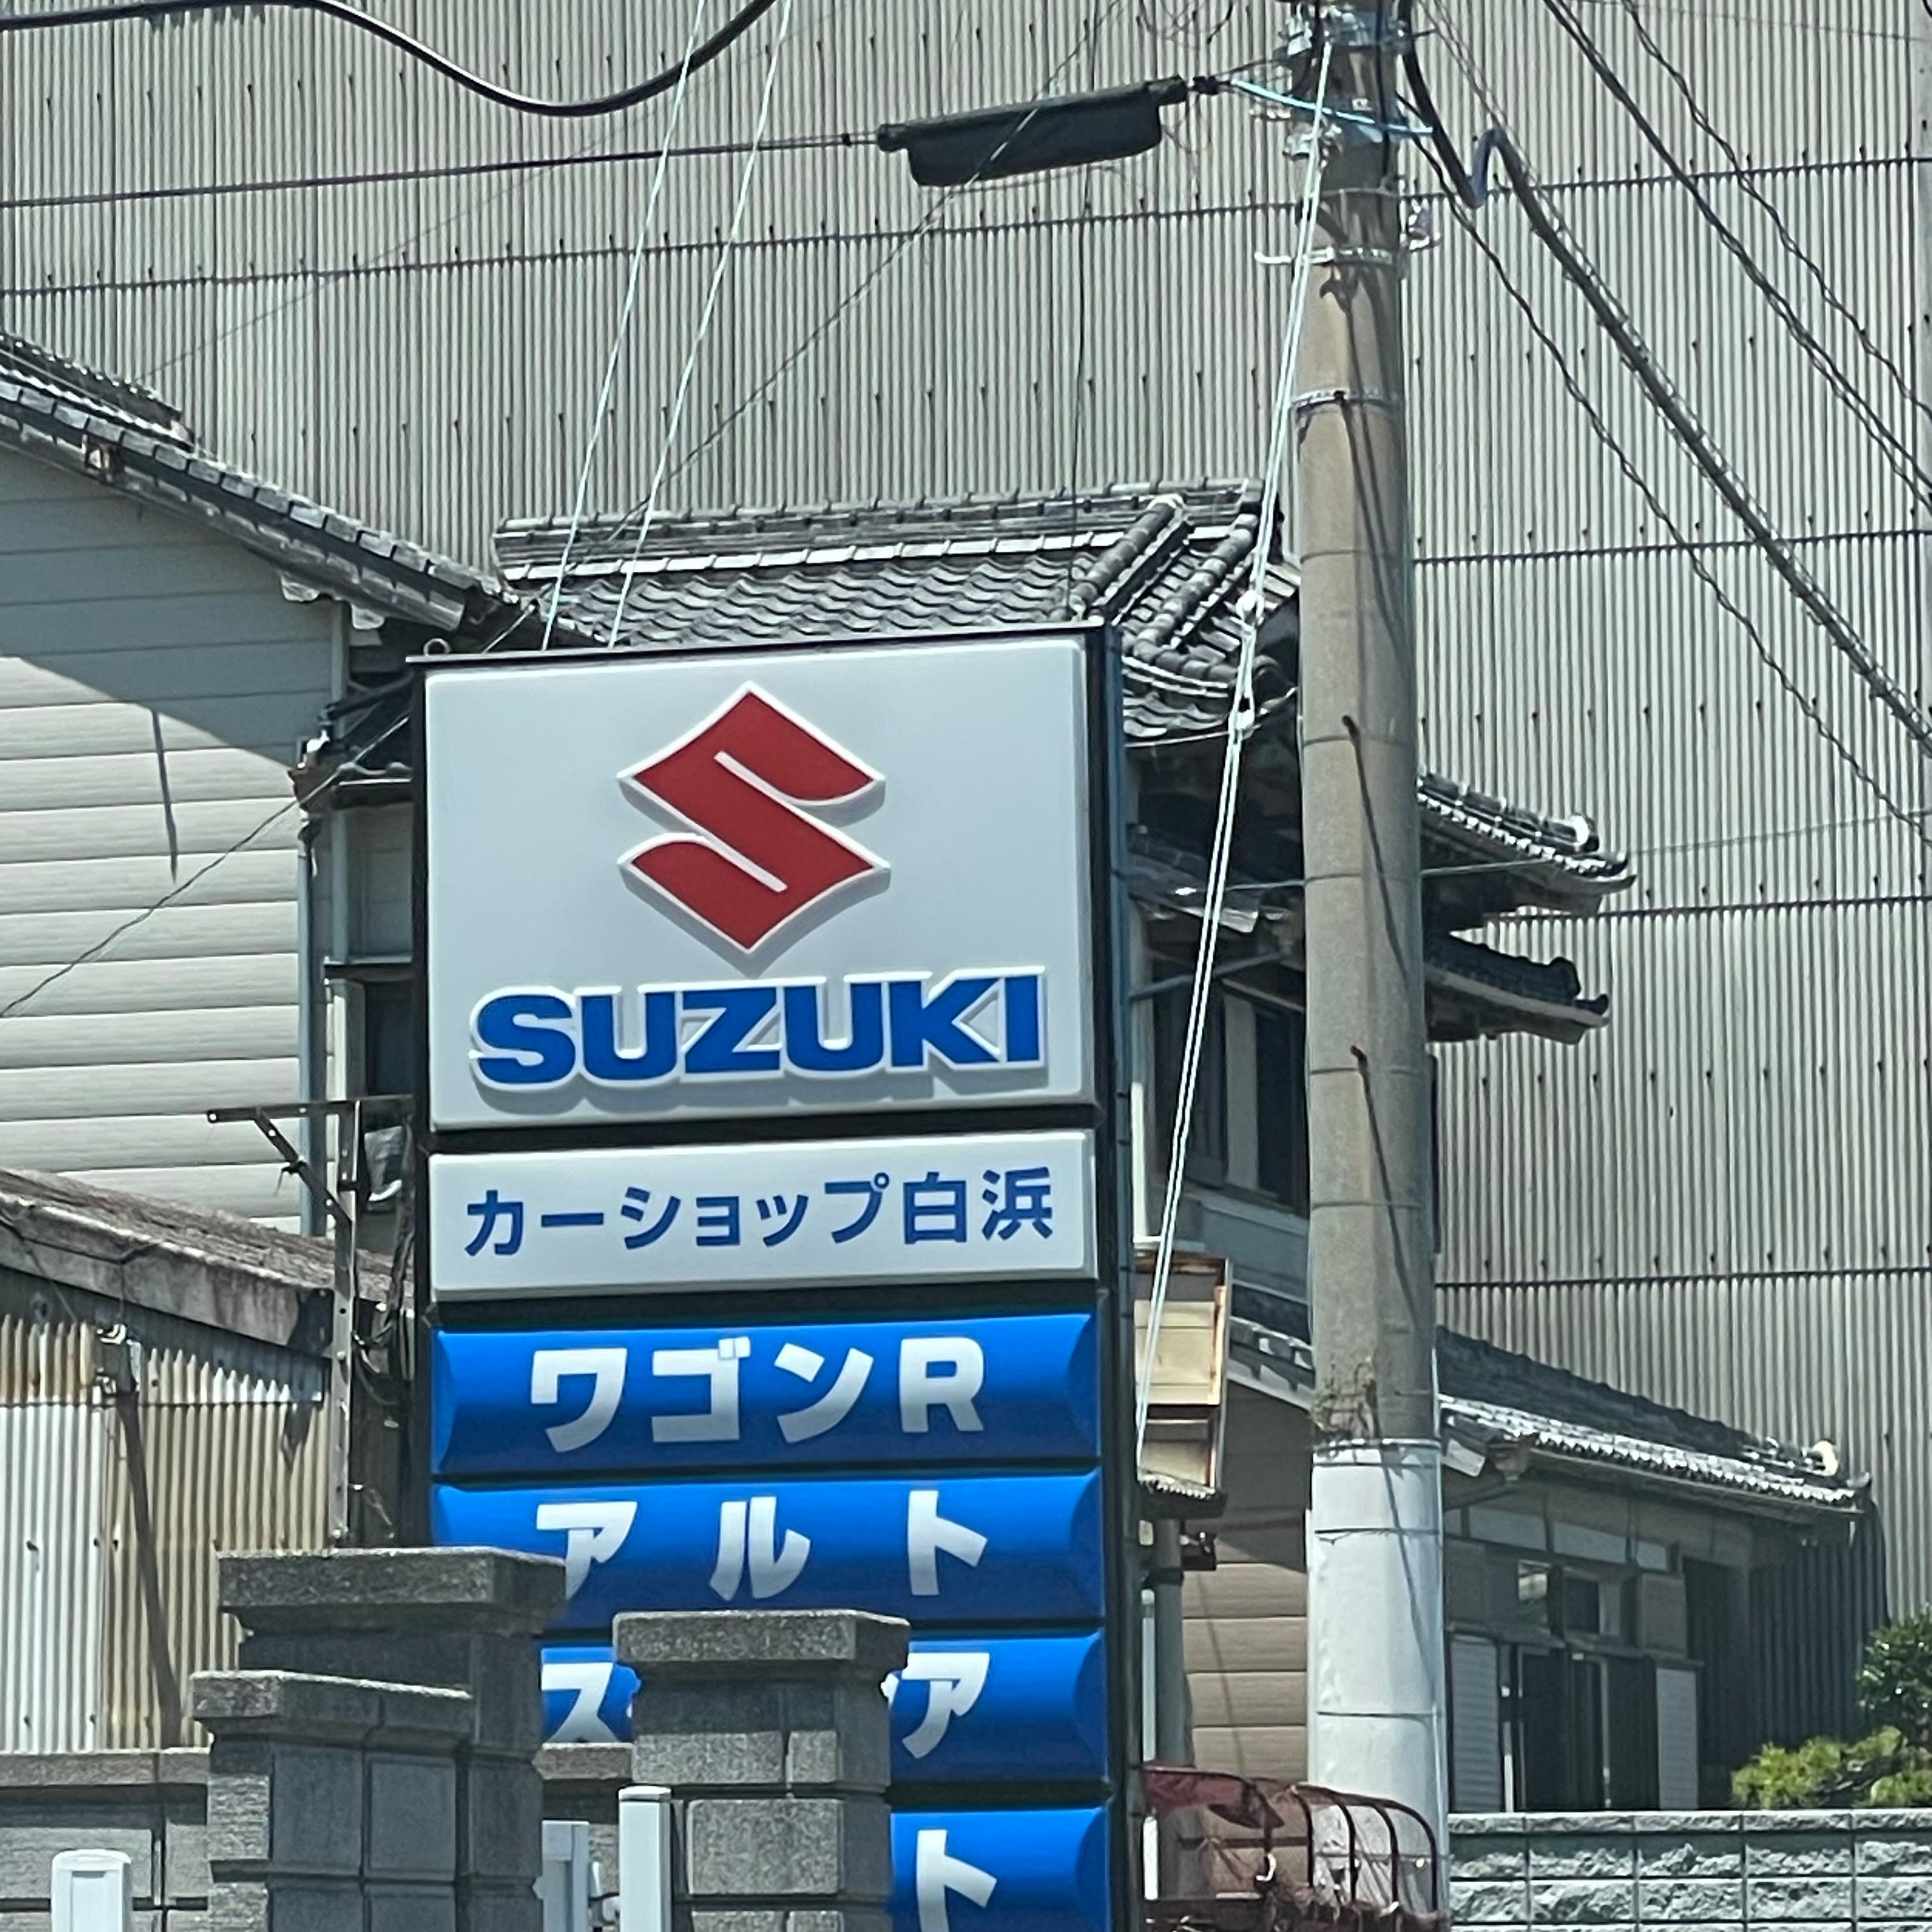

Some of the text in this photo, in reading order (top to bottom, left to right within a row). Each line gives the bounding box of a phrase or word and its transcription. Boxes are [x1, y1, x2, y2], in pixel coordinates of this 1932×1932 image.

[473, 971, 1043, 1087] SUZUKI
[464, 1166, 1054, 1257] カーショップ白浜
[531, 1337, 985, 1452] ワゴンR
[536, 1490, 988, 1600] アルト
